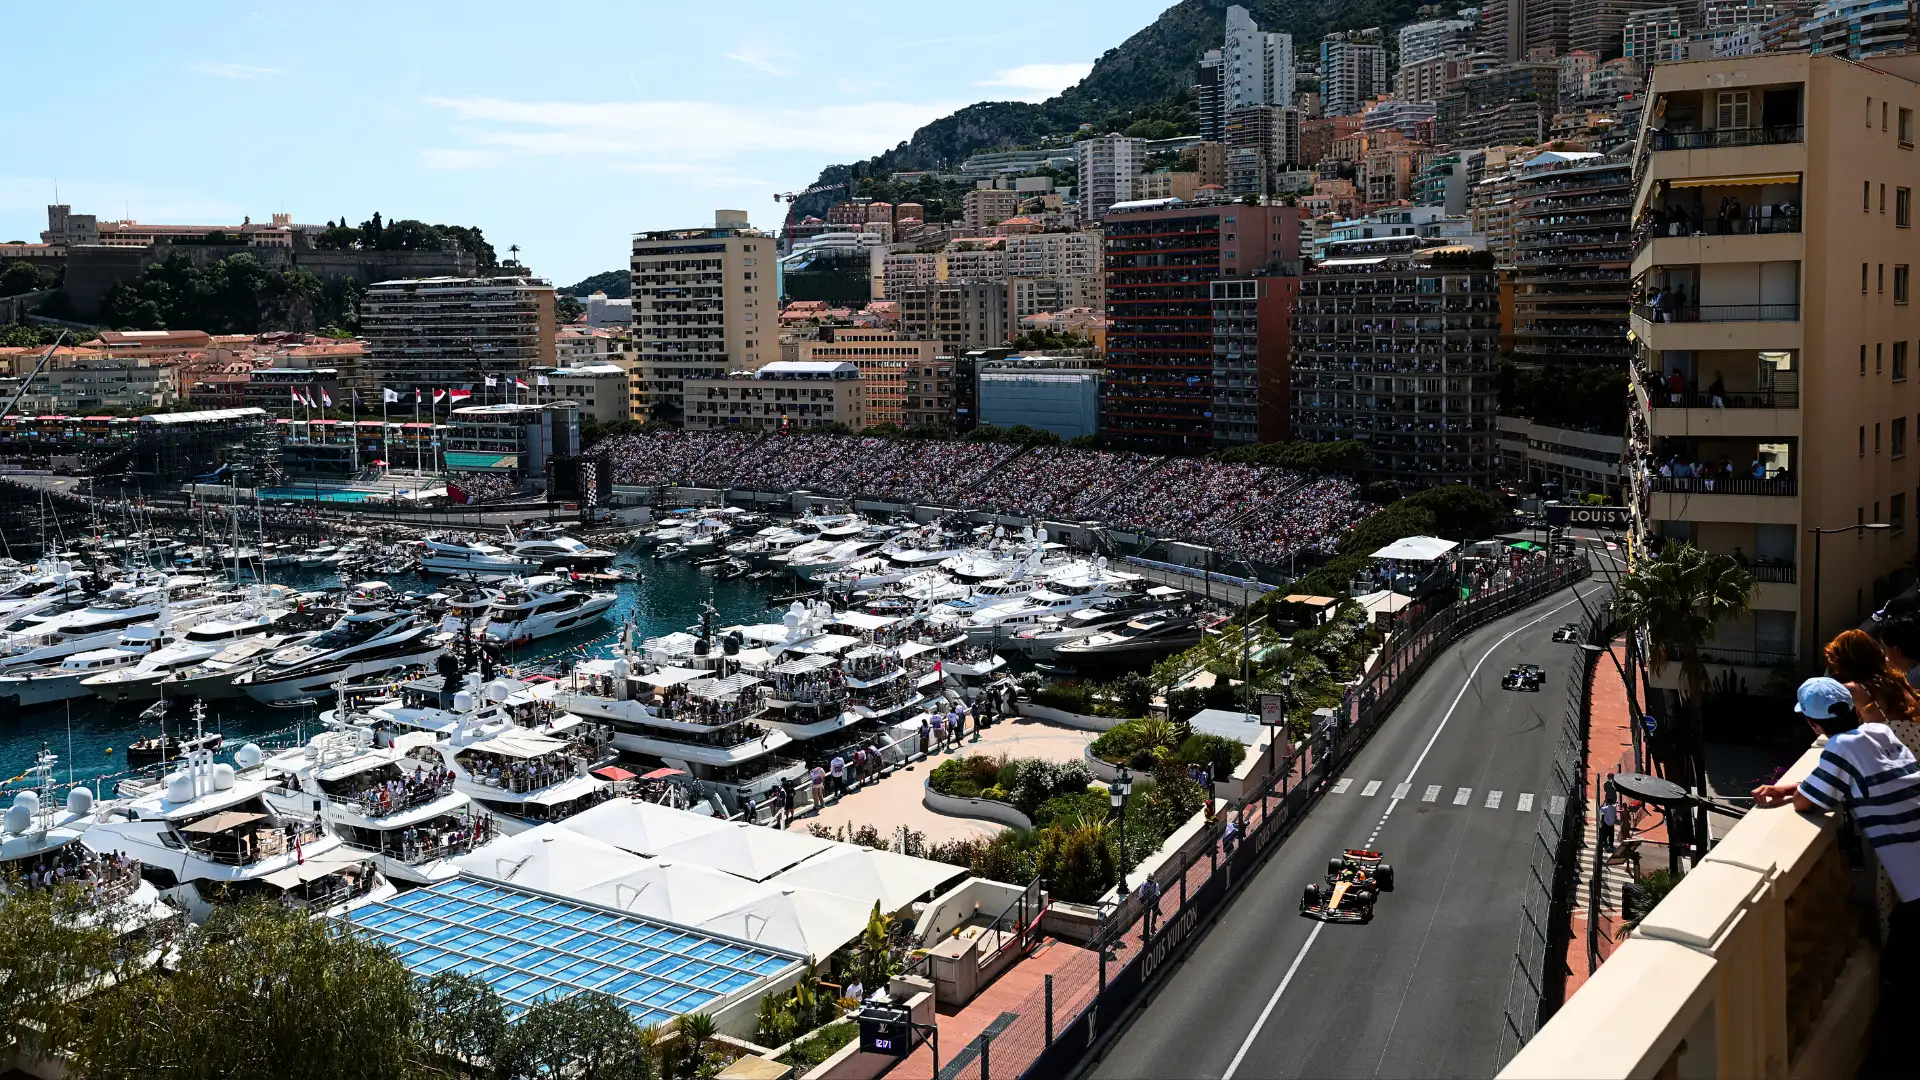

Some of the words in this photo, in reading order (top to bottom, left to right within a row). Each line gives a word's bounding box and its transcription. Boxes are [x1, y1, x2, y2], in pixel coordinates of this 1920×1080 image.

[1571, 510, 1616, 522] LOUIS
[1141, 937, 1166, 983] LOUIS
[1167, 901, 1199, 951] VUITTON
